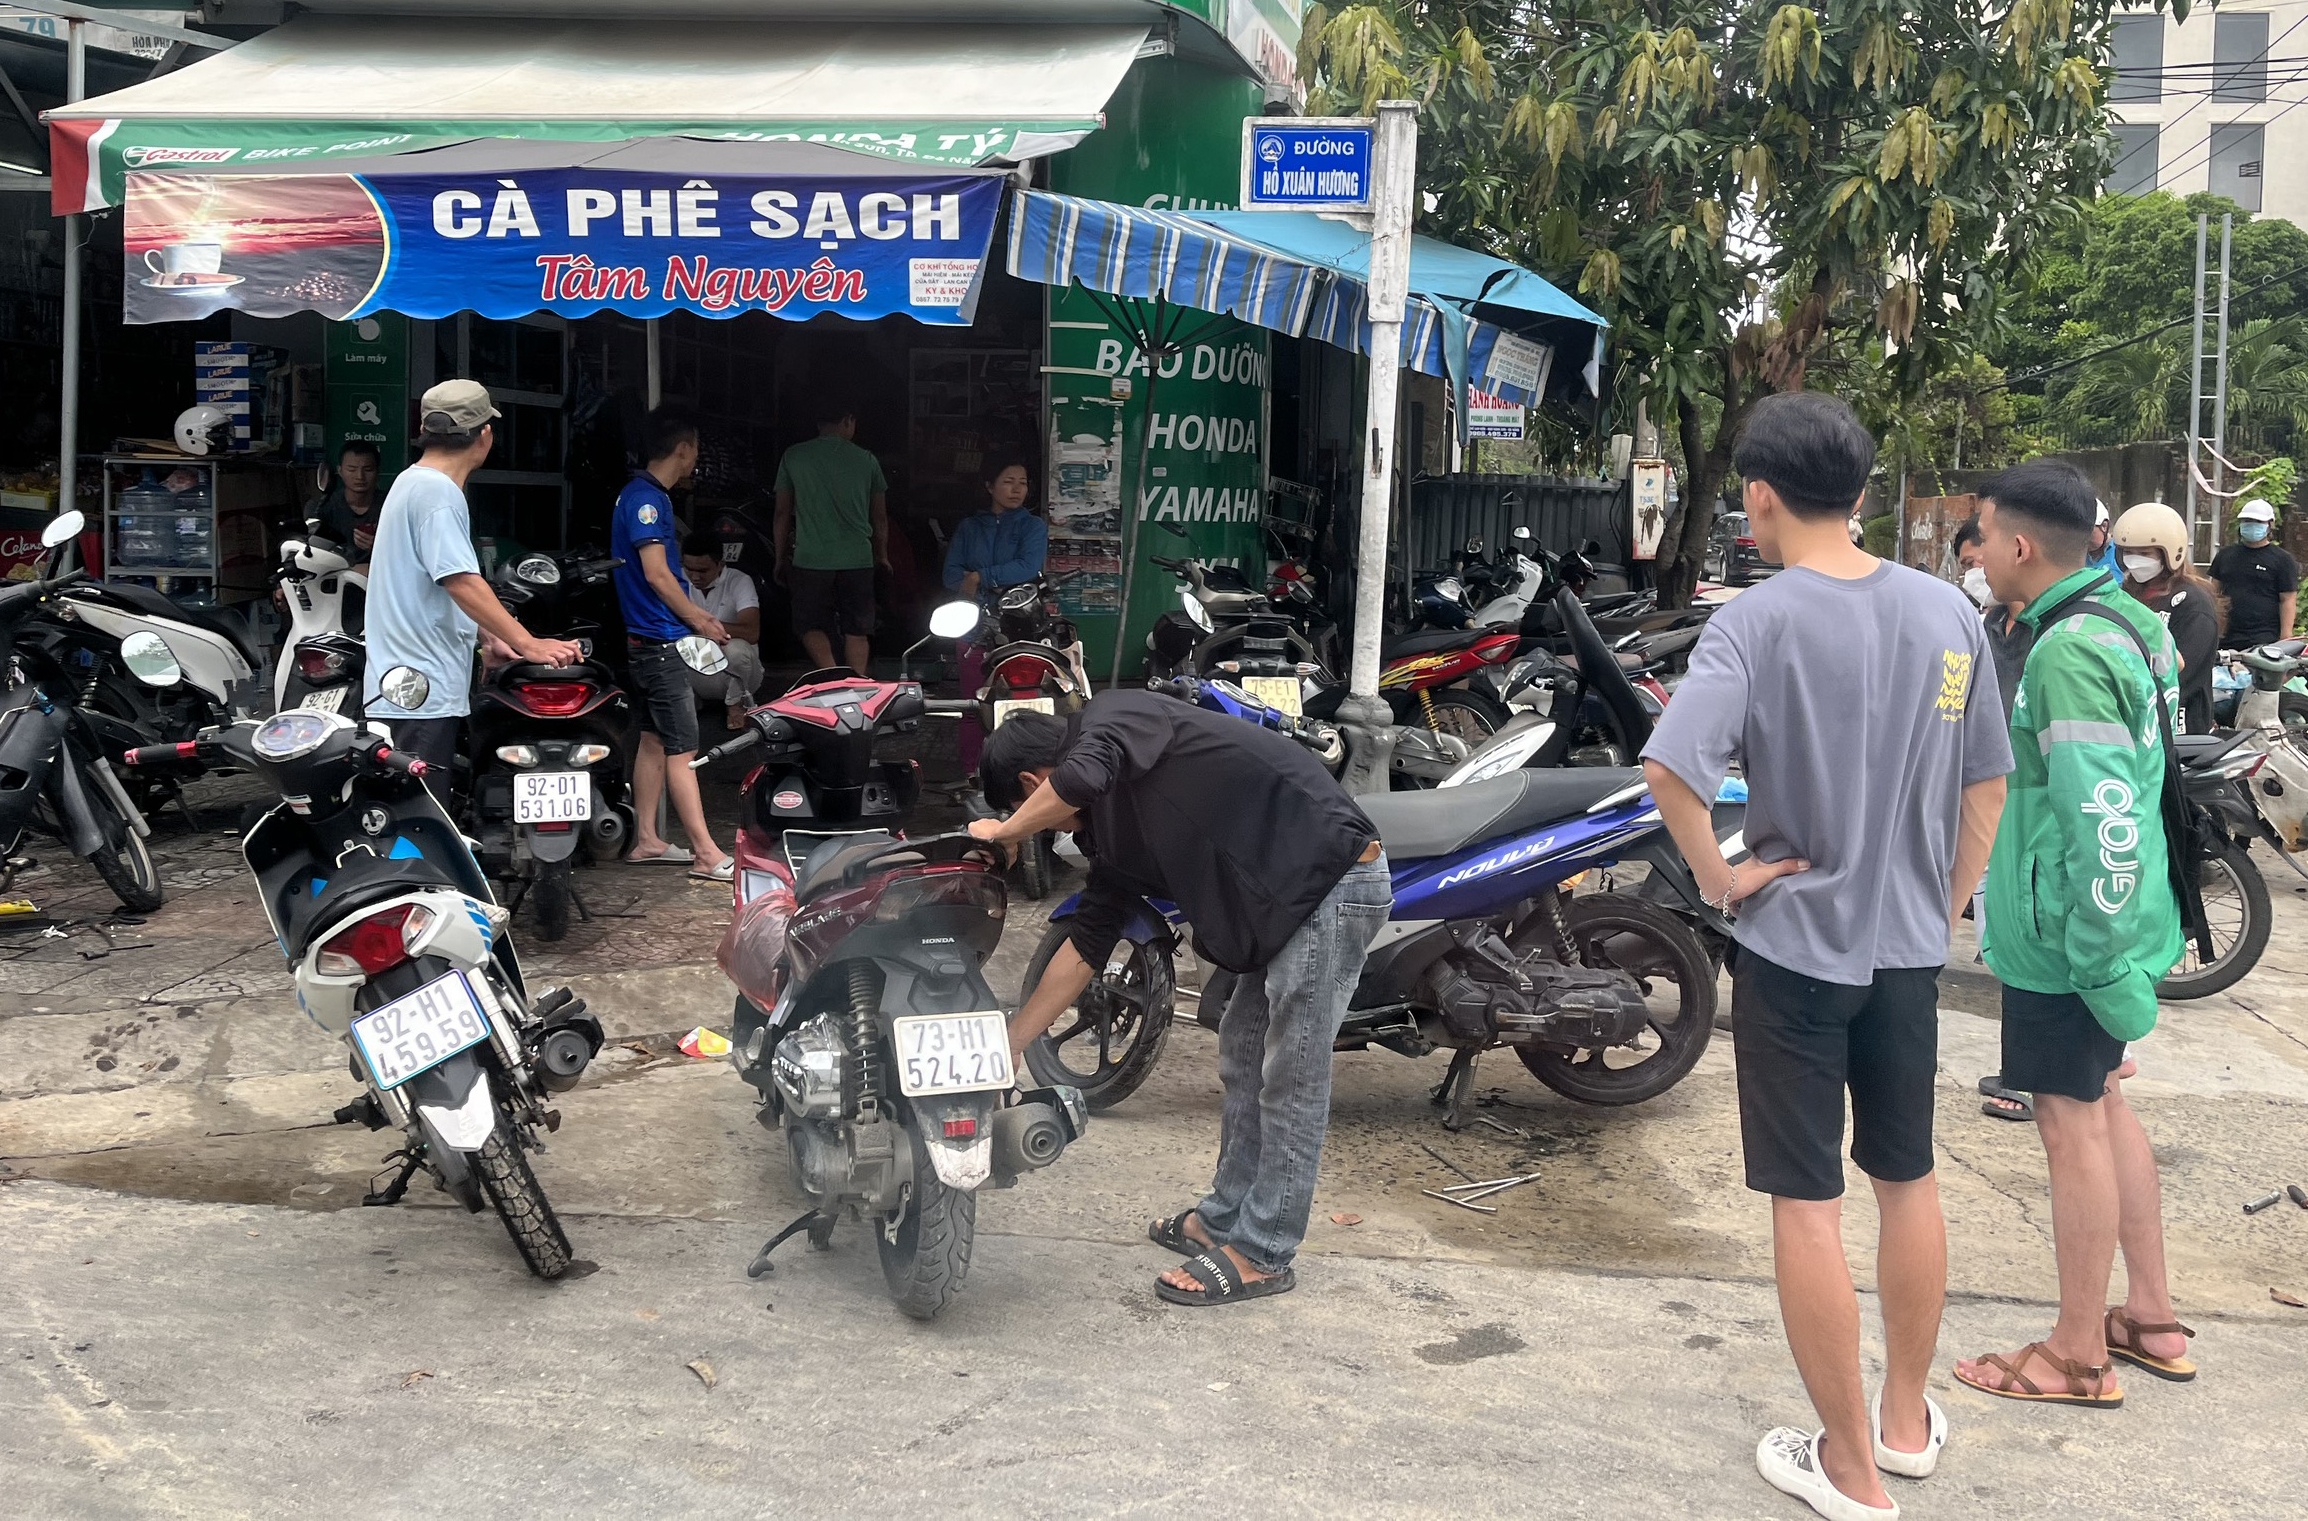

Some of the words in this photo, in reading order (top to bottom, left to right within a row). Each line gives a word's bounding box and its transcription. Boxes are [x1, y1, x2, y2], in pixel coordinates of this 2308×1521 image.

[19, 17, 55, 38] 79
[146, 149, 231, 161] Castrol
[242, 146, 320, 160] BIKE
[322, 134, 413, 153] POINT
[1294, 136, 1355, 155] ĐƯỜNG
[1263, 161, 1280, 195] HỒ
[1281, 166, 1316, 196] XUÂN
[1317, 169, 1359, 196] HƯƠNG
[432, 179, 541, 239] CÀ
[566, 179, 721, 238] PHÊ
[750, 191, 960, 250] SẠCH
[536, 253, 650, 301] Tâm
[664, 255, 867, 312] Nguyên
[207, 342, 232, 354] LARUE
[345, 354, 364, 362] Làm
[367, 354, 387, 364] máy
[1096, 329, 1183, 379] BẢO
[208, 367, 233, 378] LARUE
[209, 390, 233, 402] LARUE
[1148, 413, 1256, 454] HONDA
[1139, 486, 1258, 522] YAMAHA
[1251, 680, 1289, 696] 75-E1
[527, 776, 577, 796] 92-D1
[520, 798, 586, 819] 531.06
[1437, 836, 1555, 889] NOUVO
[2081, 778, 2139, 915] Grab
[922, 937, 955, 945] HONDA
[372, 984, 453, 1043] 92-H1
[379, 1010, 480, 1080] 459.59
[912, 1019, 986, 1053] 73-H1
[908, 1051, 1006, 1088] 524.20
[1202, 1256, 1231, 1295] FURTHER
